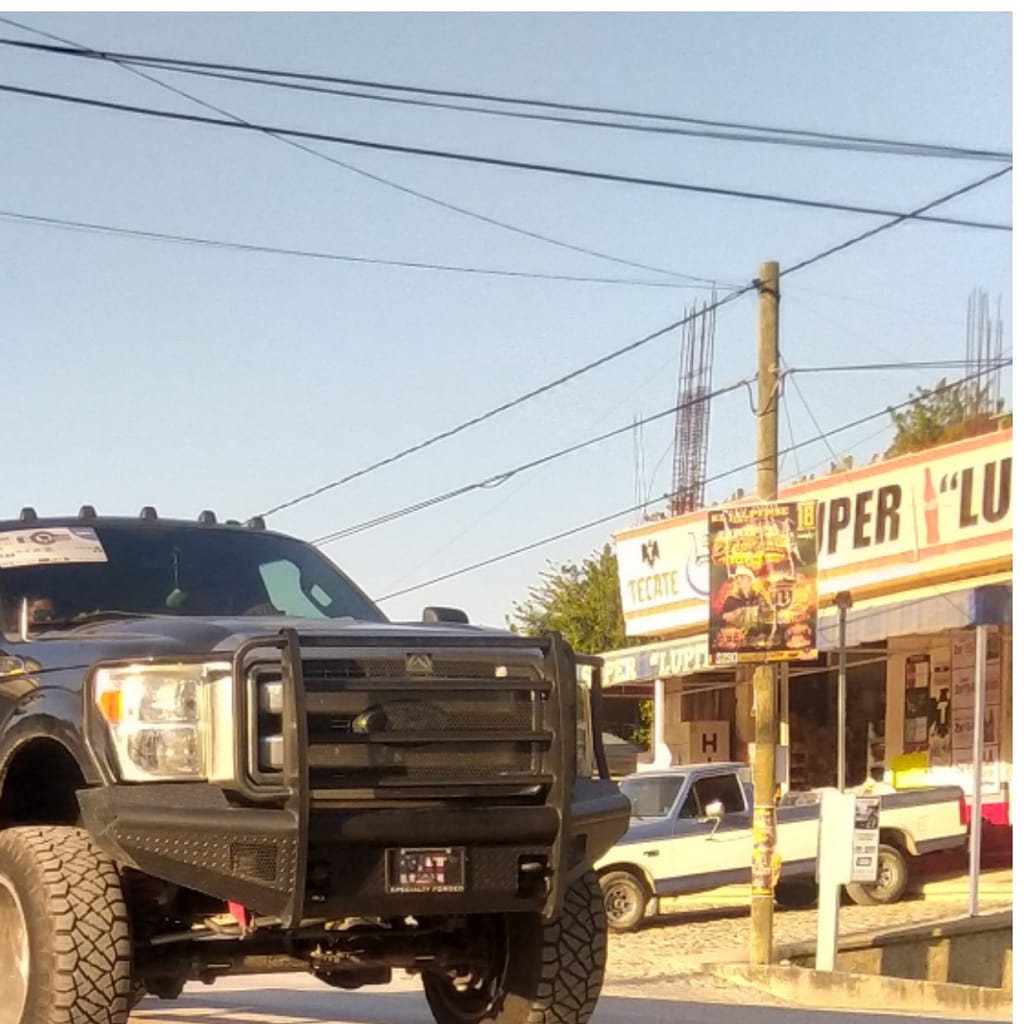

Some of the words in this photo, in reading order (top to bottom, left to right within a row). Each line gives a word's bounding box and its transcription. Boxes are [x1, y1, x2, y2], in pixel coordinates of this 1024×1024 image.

[797, 503, 815, 528] 18
[627, 570, 680, 603] TECATE
[701, 732, 718, 753] H
